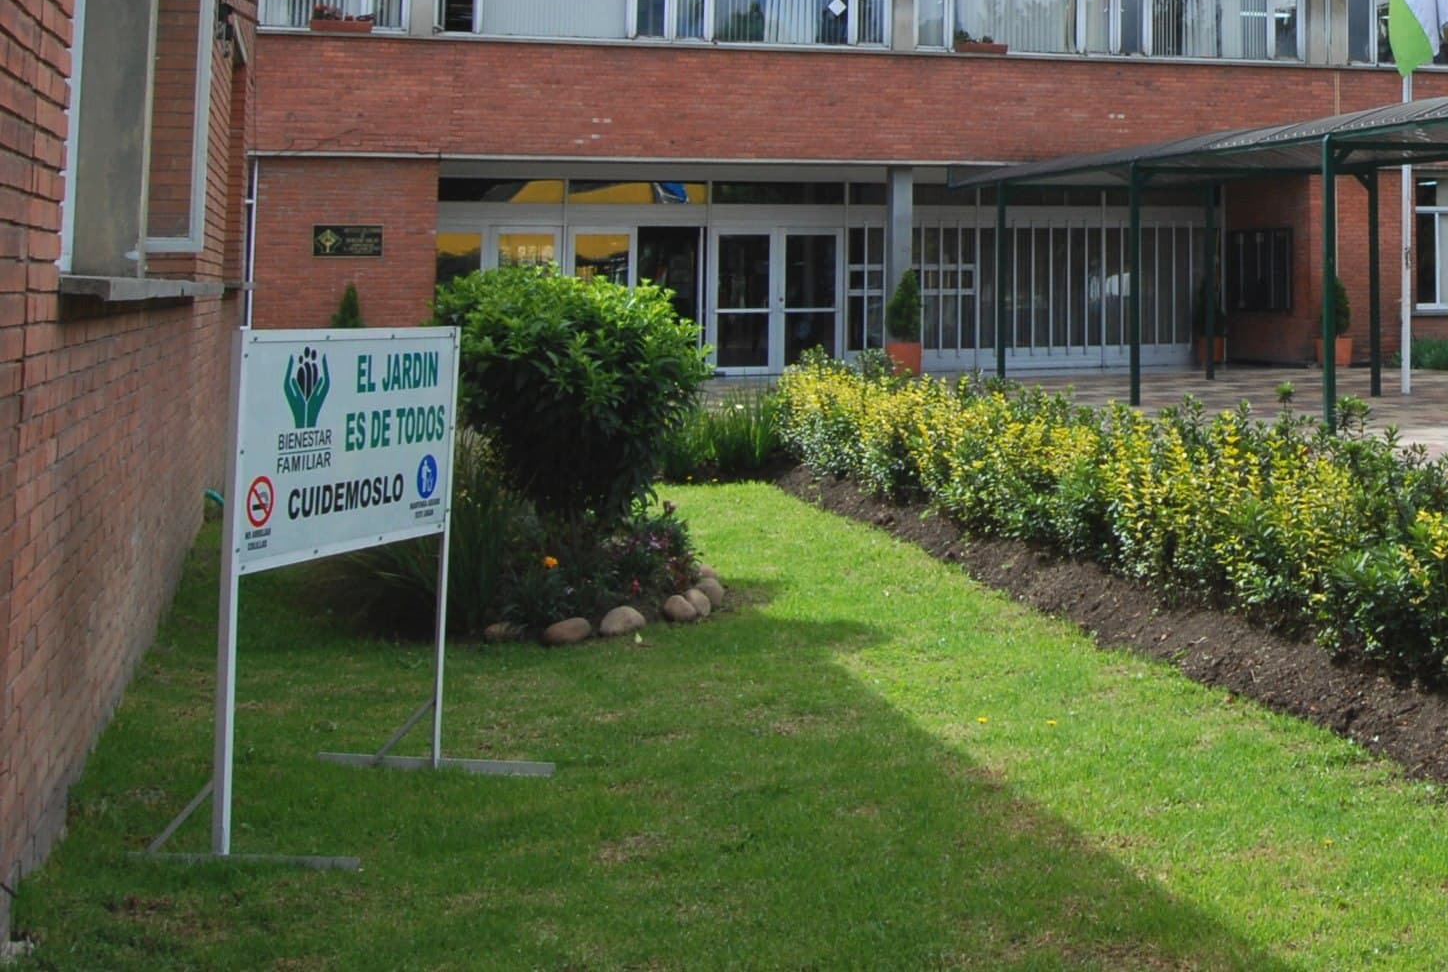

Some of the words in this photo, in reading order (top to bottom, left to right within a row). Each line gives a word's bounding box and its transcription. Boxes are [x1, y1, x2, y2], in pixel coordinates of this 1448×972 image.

[356, 354, 376, 393] EL
[382, 351, 439, 392] JARDIN
[278, 429, 332, 451] BIENESTAR
[345, 412, 365, 452] ES
[370, 409, 392, 448] DE
[396, 405, 445, 445] TODOS
[276, 451, 332, 474] FAMILIAR
[287, 473, 404, 520] CUIDEMOSLO
